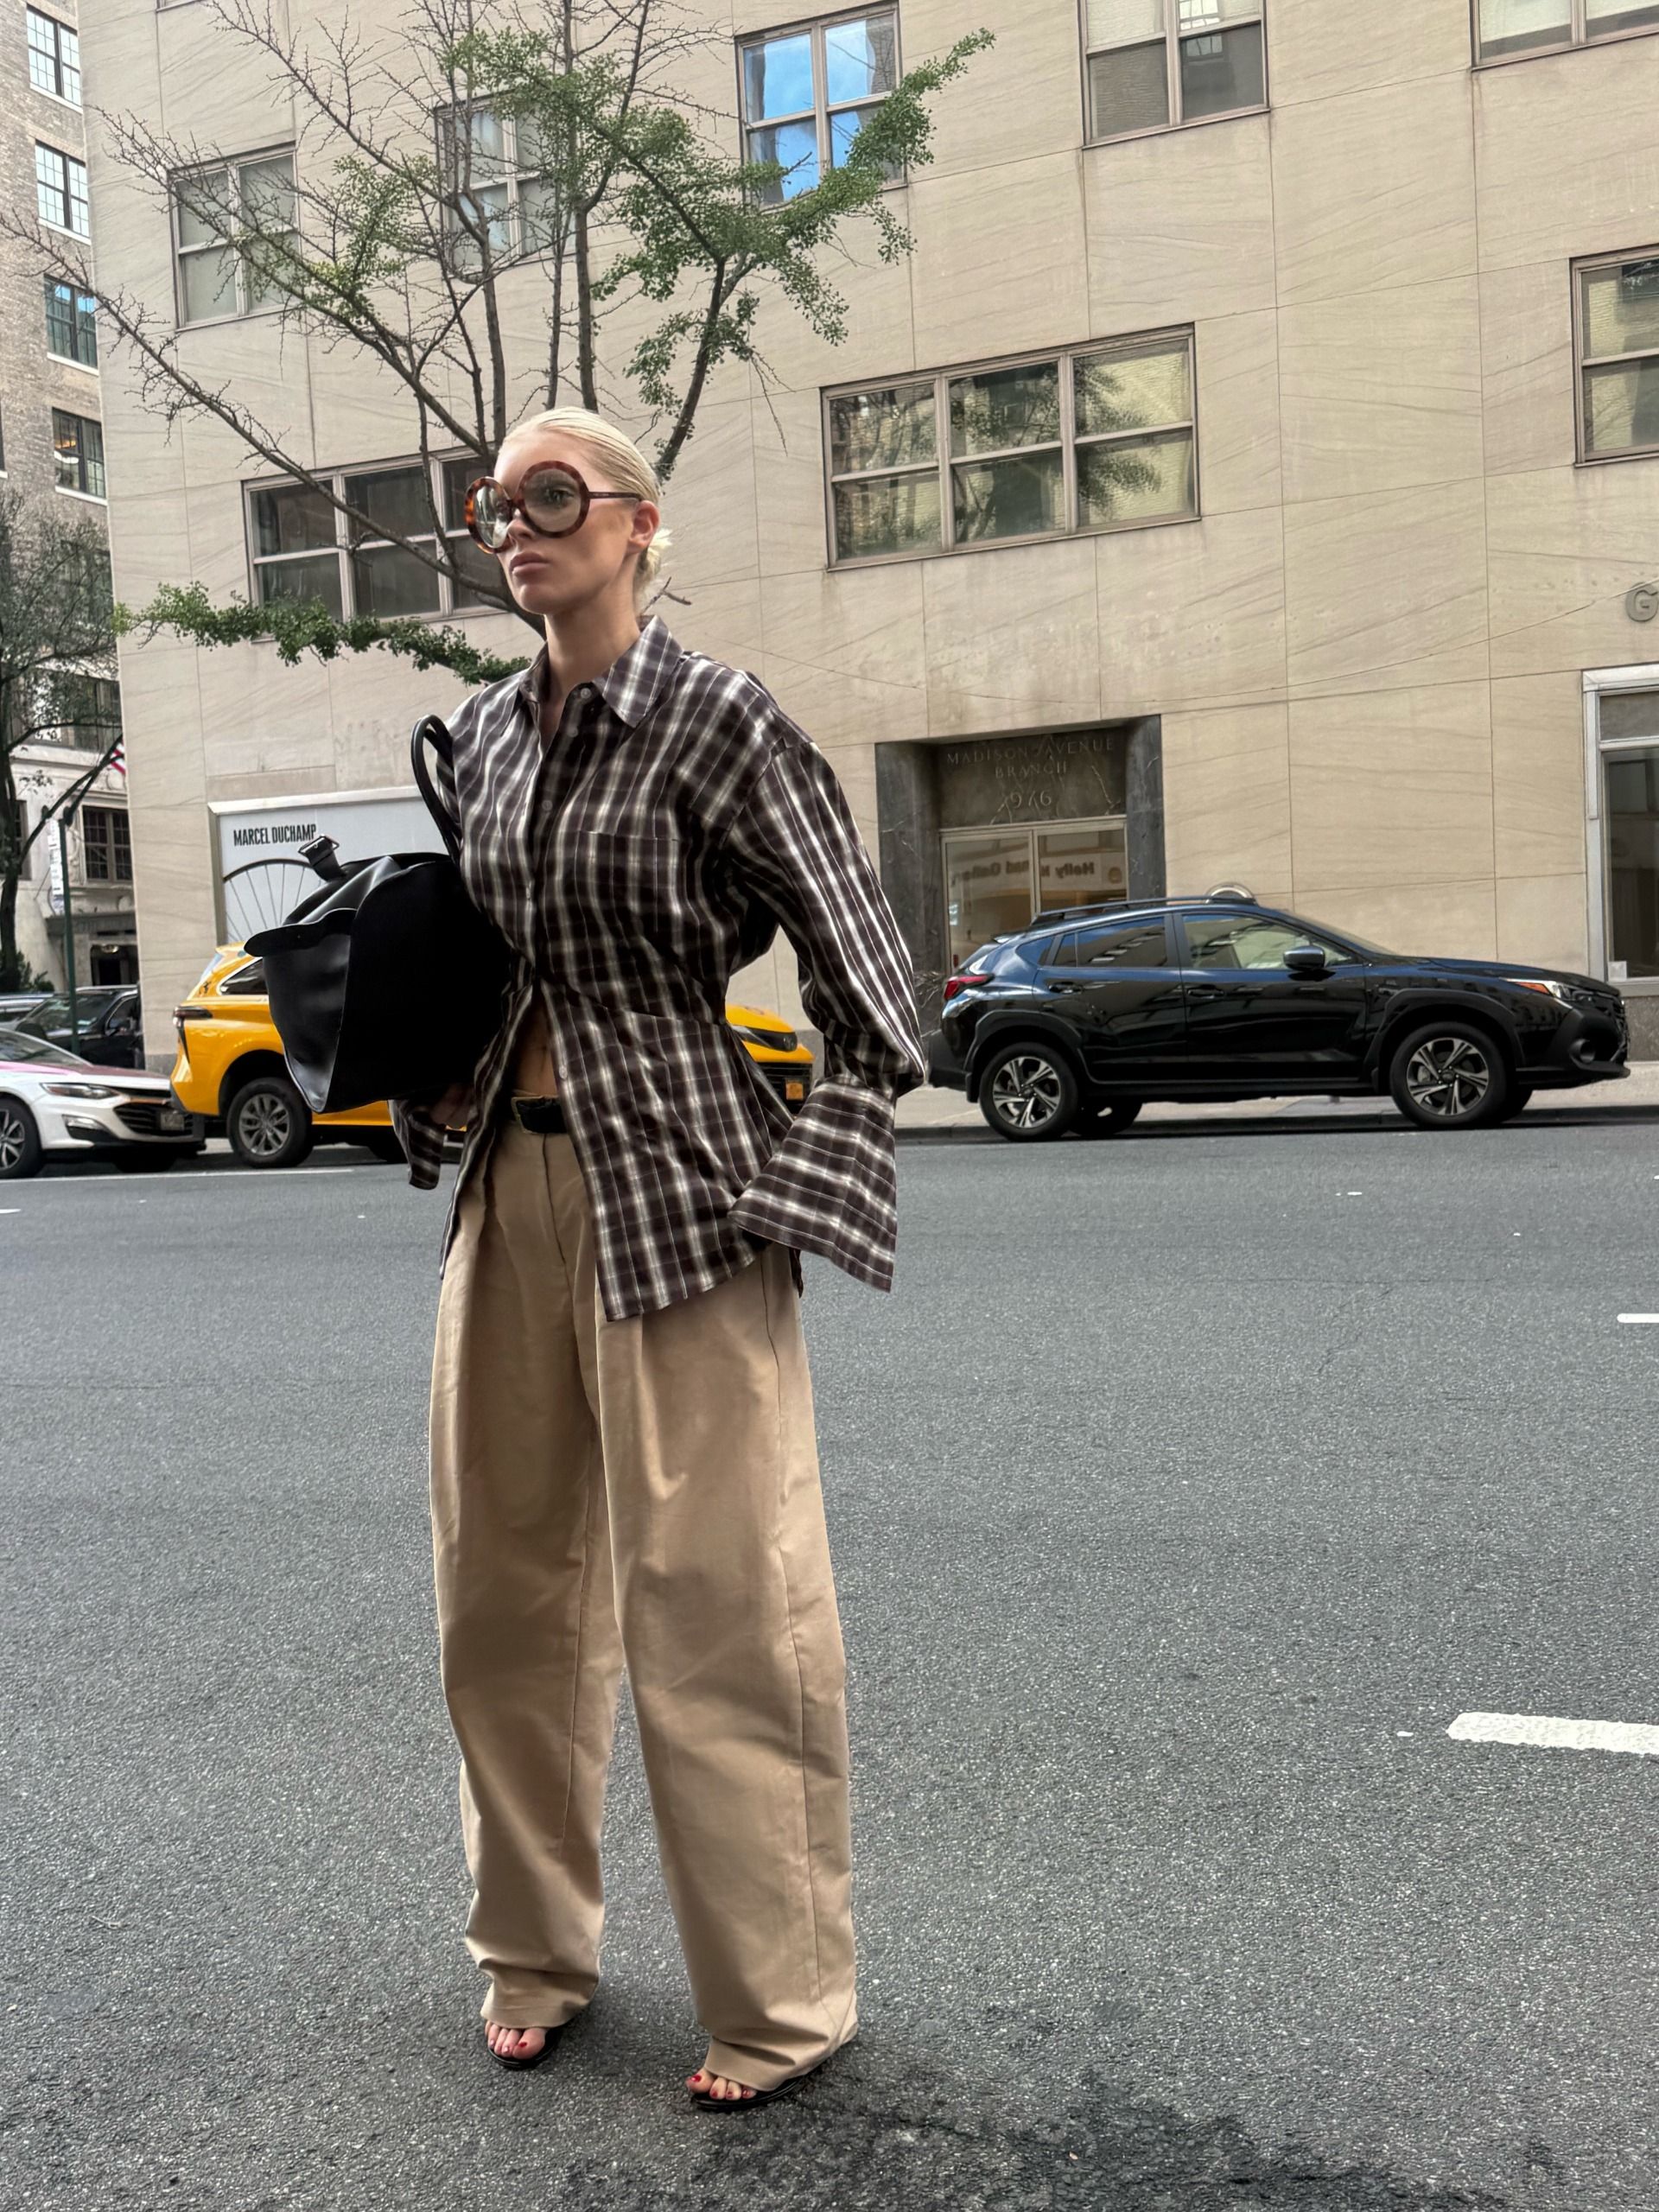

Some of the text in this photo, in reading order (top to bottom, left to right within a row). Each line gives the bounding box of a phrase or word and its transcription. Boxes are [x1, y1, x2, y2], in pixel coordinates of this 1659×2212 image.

[947, 738, 1114, 765] MADISON AVENUE
[995, 761, 1067, 779] BRANCH
[233, 823, 316, 846] MARCEL DUCHAMP
